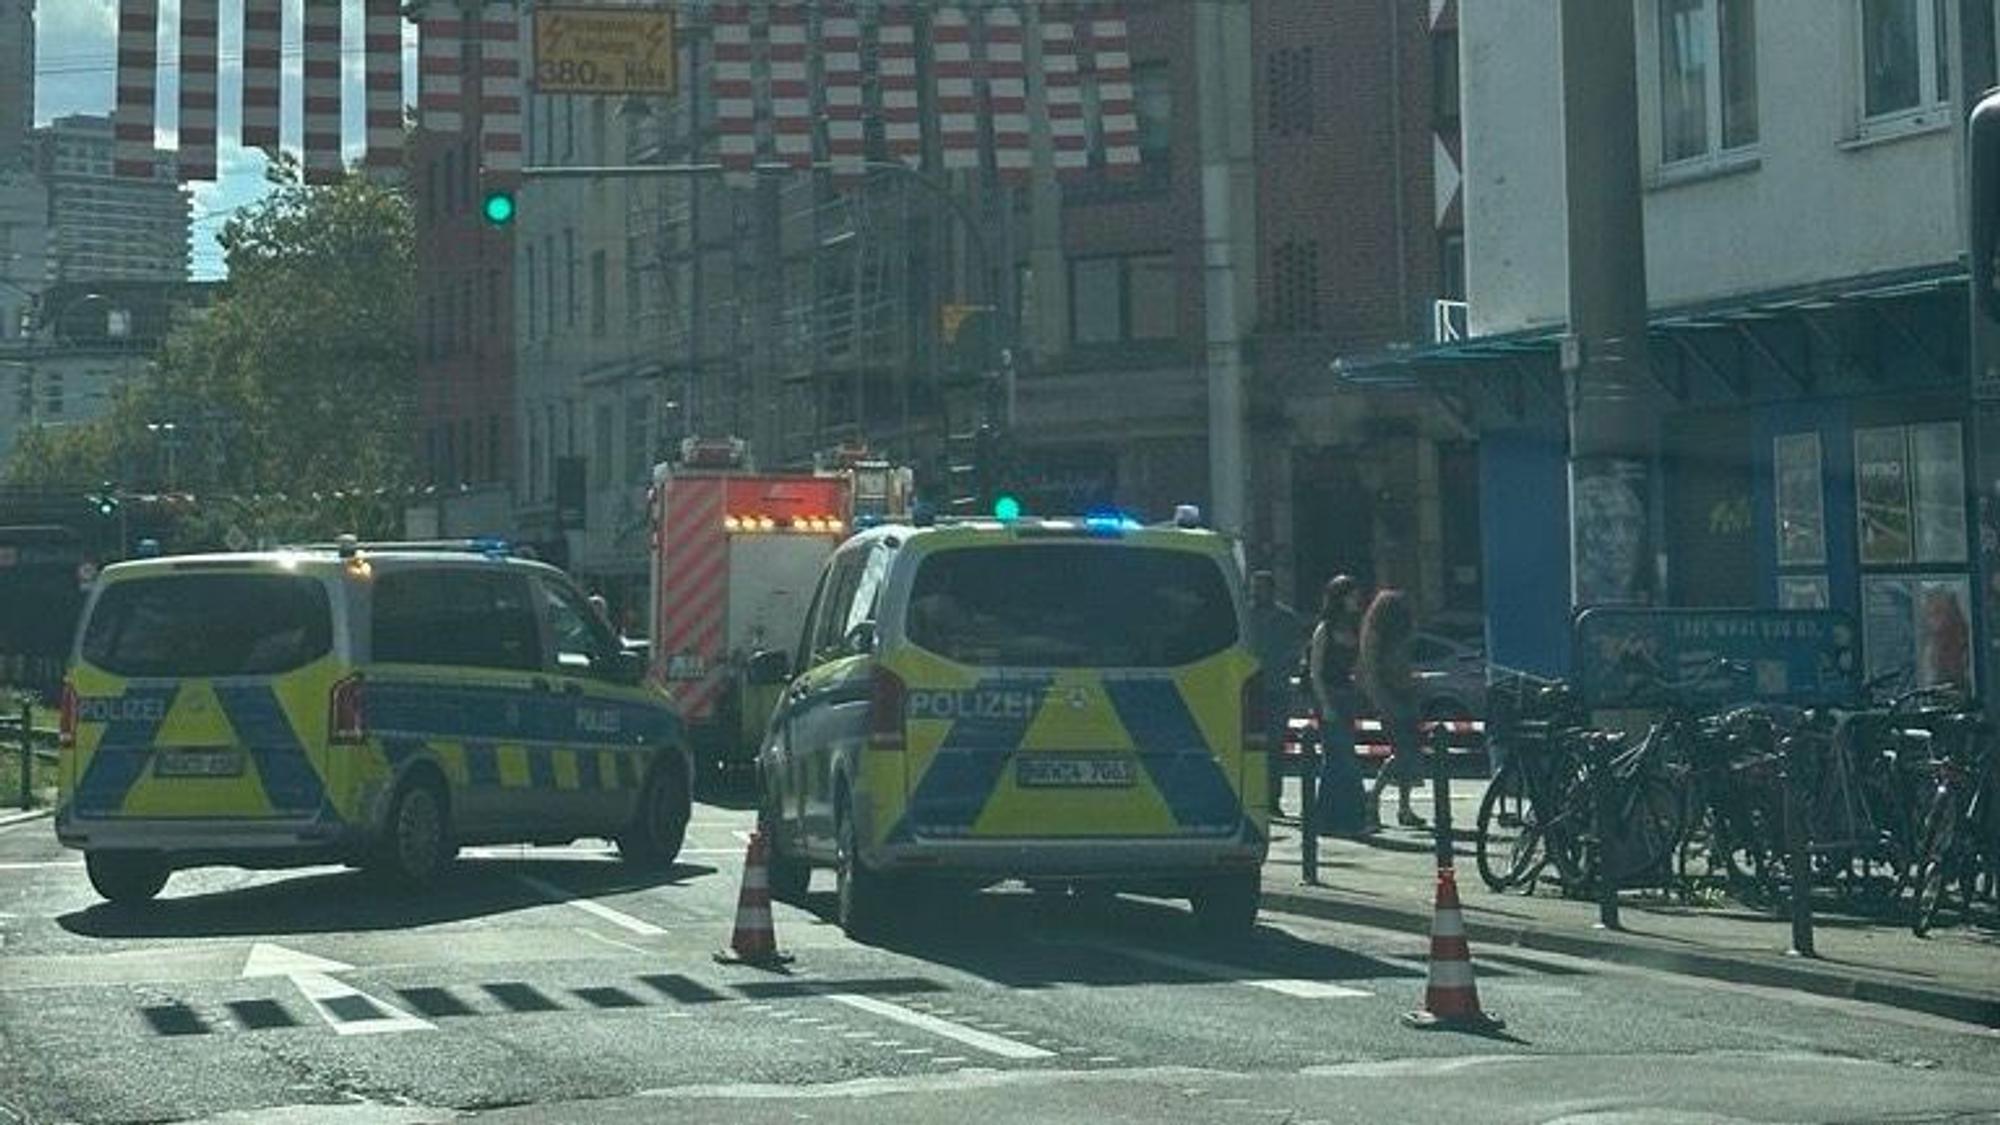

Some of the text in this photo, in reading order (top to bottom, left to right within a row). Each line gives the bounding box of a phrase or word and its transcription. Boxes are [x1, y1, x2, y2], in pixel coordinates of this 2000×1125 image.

[539, 59, 598, 84] 380
[79, 697, 163, 719] POLIZEI
[909, 690, 1033, 718] POLIZEI
